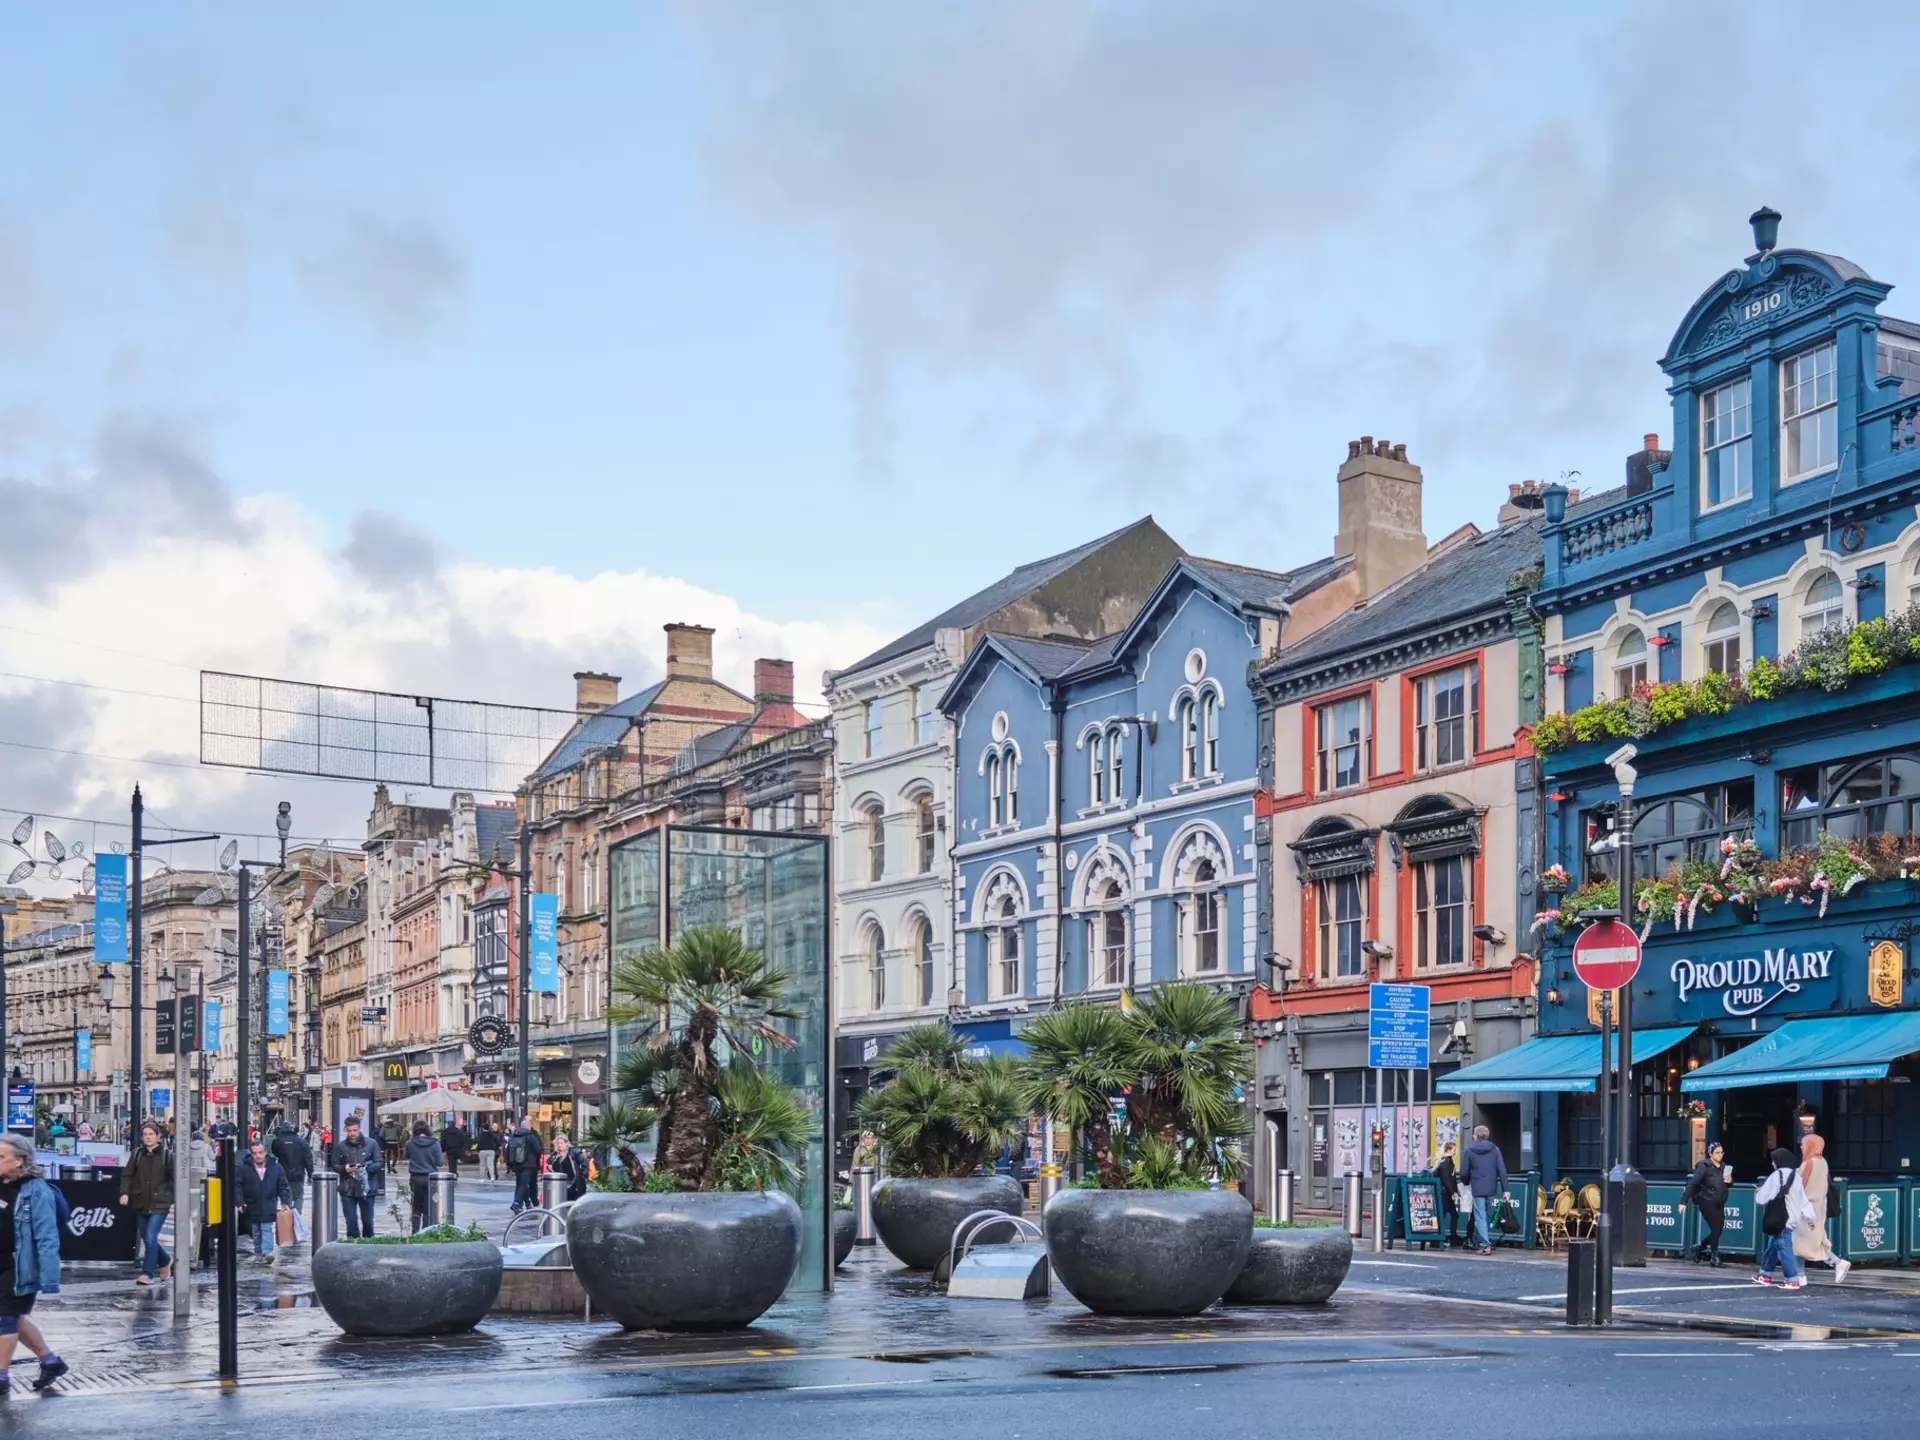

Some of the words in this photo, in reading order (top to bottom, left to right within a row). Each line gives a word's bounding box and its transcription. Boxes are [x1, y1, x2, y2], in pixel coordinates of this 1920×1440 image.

[1745, 293, 1781, 320] 1910
[1670, 958, 1762, 1003] PROUD
[1763, 948, 1834, 988] MARY
[1732, 987, 1763, 1005] PUB
[1646, 1204, 1672, 1214] BEER
[1650, 1216, 1675, 1226] FOOD
